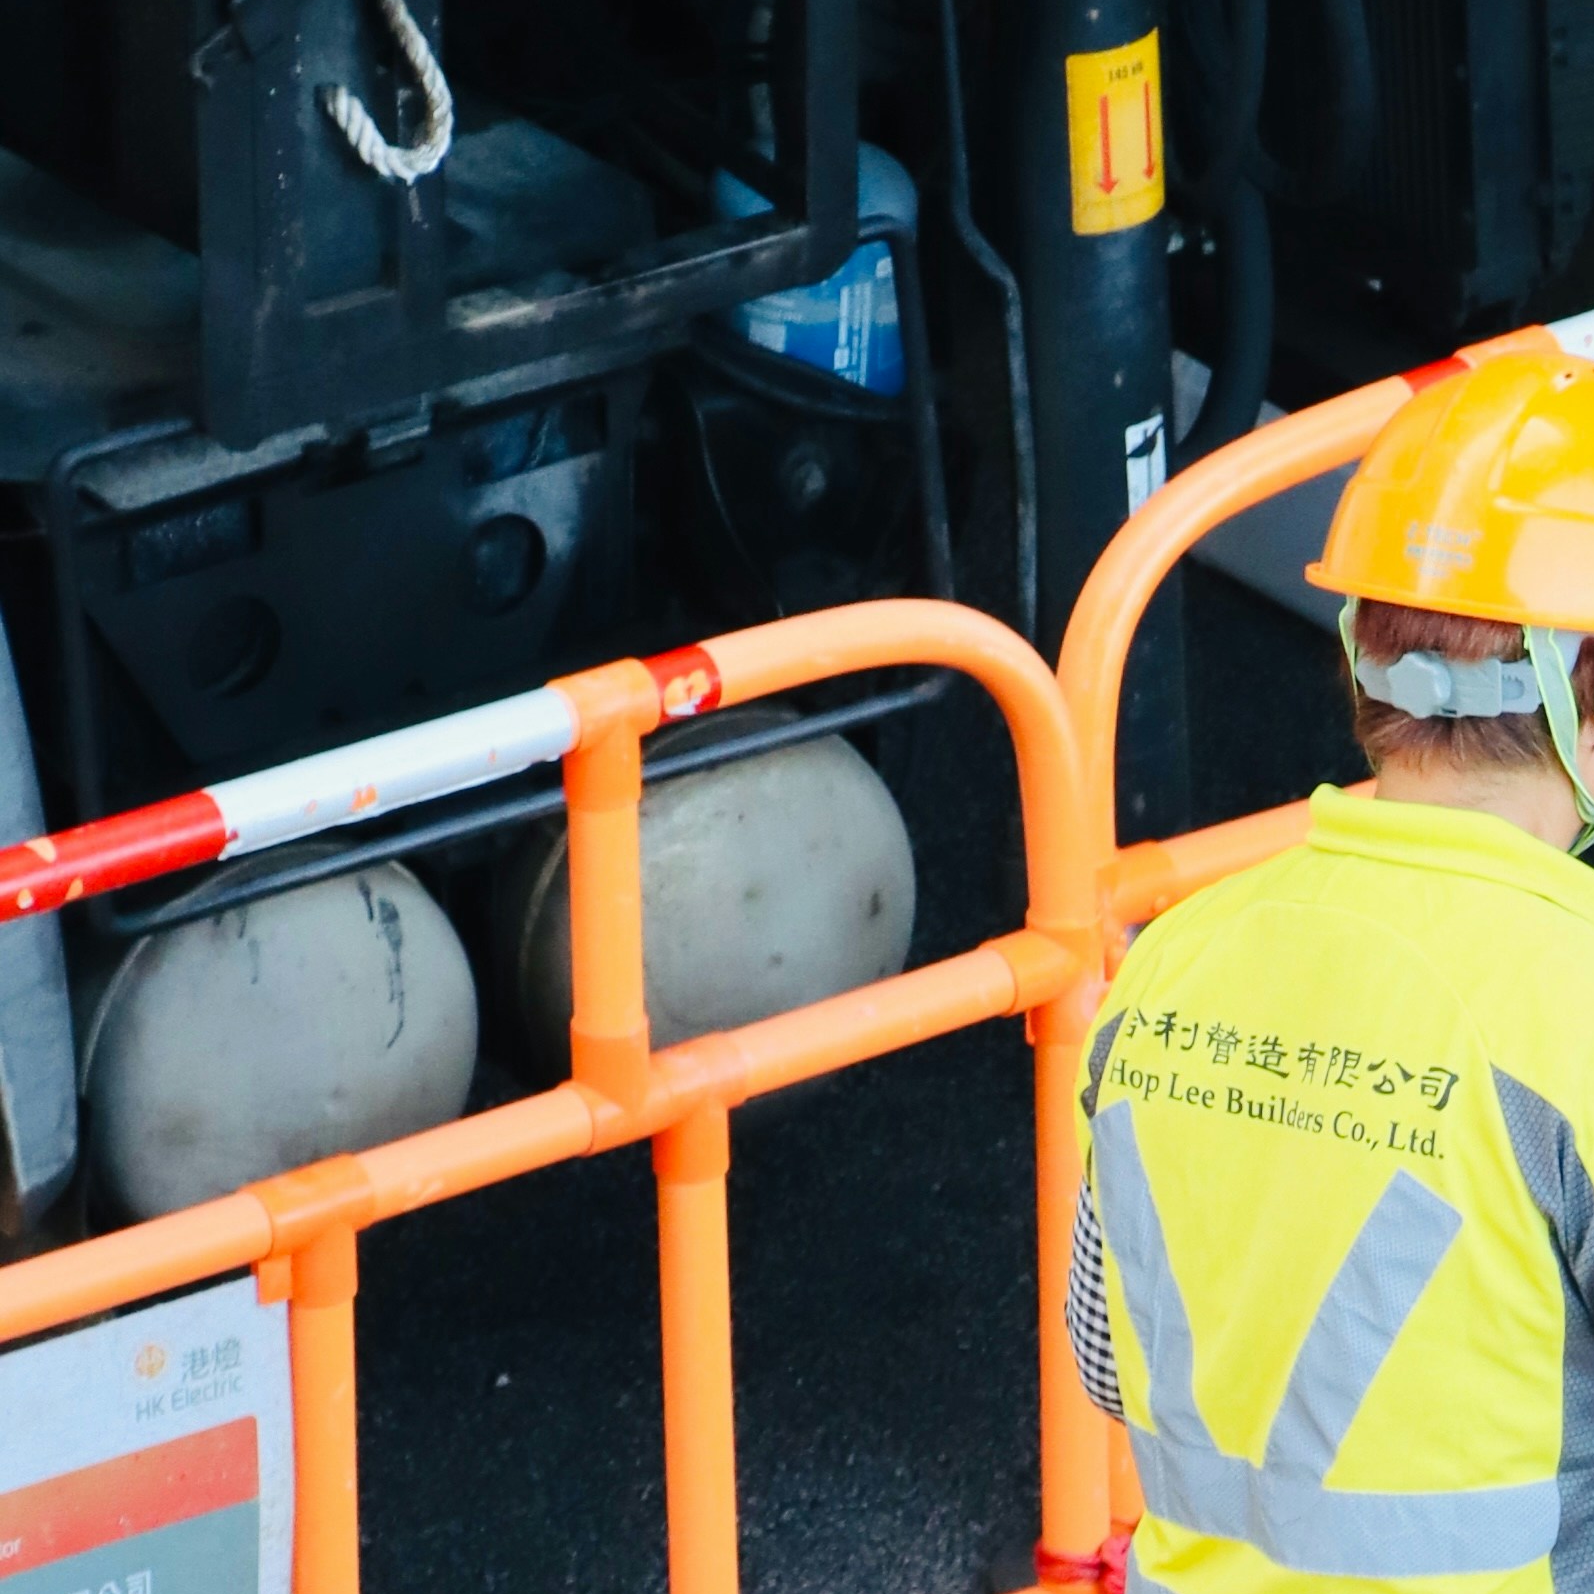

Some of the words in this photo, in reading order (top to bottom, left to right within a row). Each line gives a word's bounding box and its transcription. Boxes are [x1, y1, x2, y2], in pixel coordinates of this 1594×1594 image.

[1109, 1058, 1160, 1101] Hop
[1168, 1072, 1215, 1109] Lee
[1226, 1087, 1324, 1133] Builders
[1333, 1111, 1378, 1151] Co.,
[1387, 1120, 1444, 1159] Ltd.
[135, 1394, 165, 1422] HK
[171, 1375, 242, 1411] Electric
